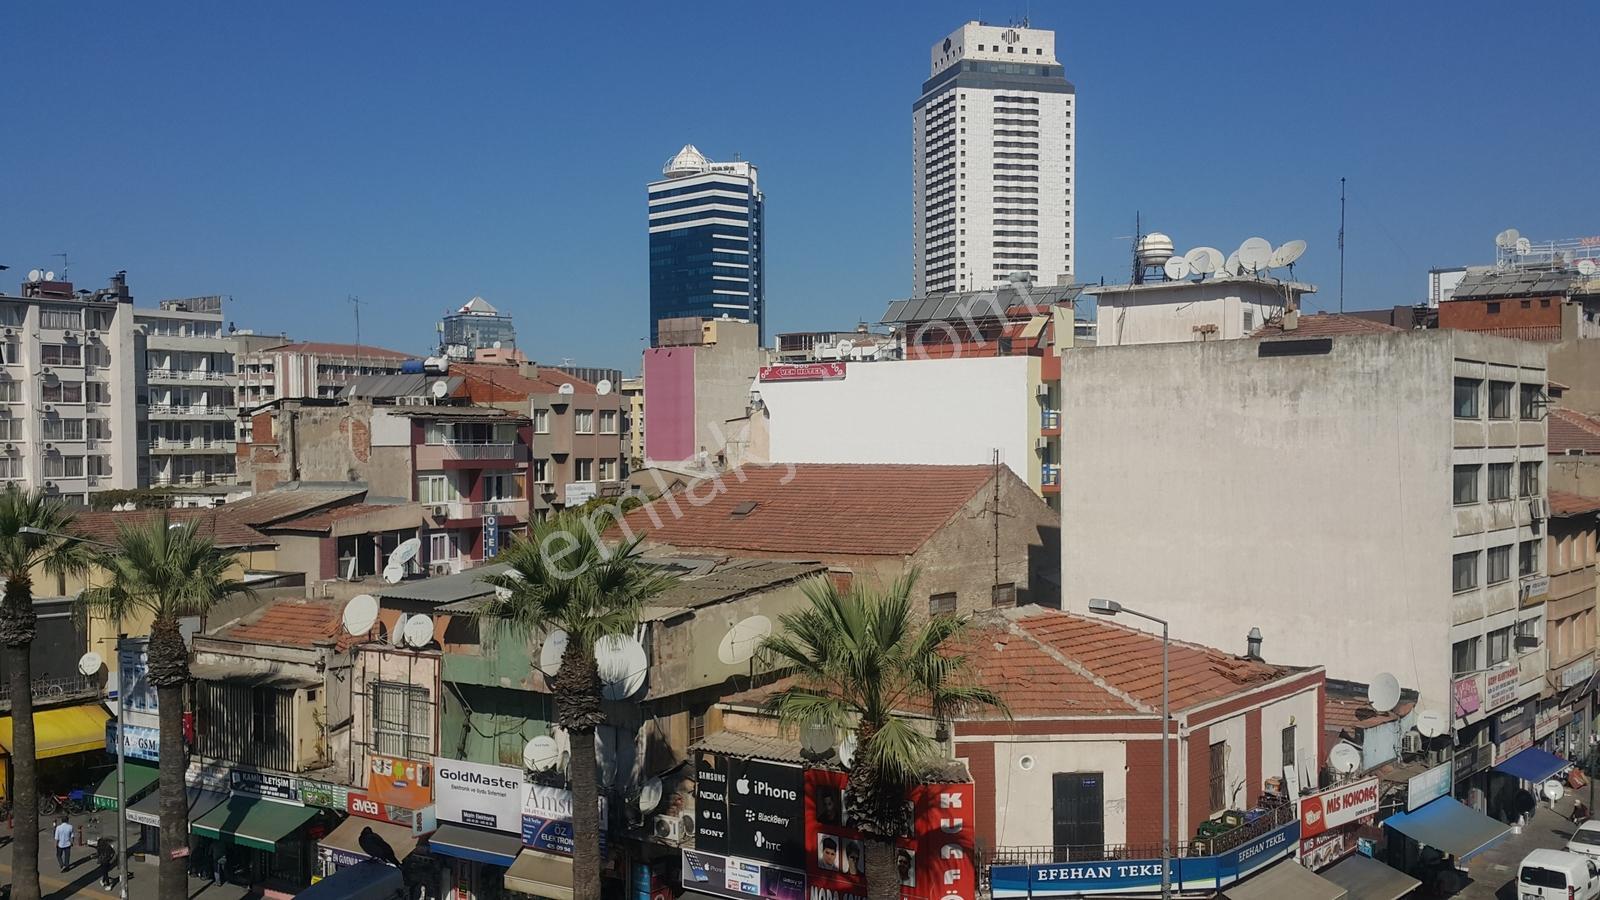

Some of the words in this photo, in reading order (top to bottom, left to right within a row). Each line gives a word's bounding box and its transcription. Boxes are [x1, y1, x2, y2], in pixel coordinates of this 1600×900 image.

[487, 516, 496, 558] OTEL
[138, 738, 156, 750] GSM
[262, 775, 289, 788] İLETİŞİM
[440, 768, 519, 790] GoldMaster
[699, 771, 726, 783] SAMSUNG
[700, 790, 724, 801] NOKIA
[753, 780, 797, 801] iPhone
[352, 798, 378, 815] avea
[711, 811, 721, 820] LG
[758, 812, 789, 828] BlackBerry
[554, 823, 567, 836] ÖZ
[700, 828, 724, 838] SONY
[541, 833, 574, 846] ELEKTRON
[1238, 841, 1265, 863] EFEHAN
[1265, 832, 1286, 849] TEKEL
[1037, 866, 1112, 881] EFEHAN
[1118, 864, 1173, 877] TEKE
